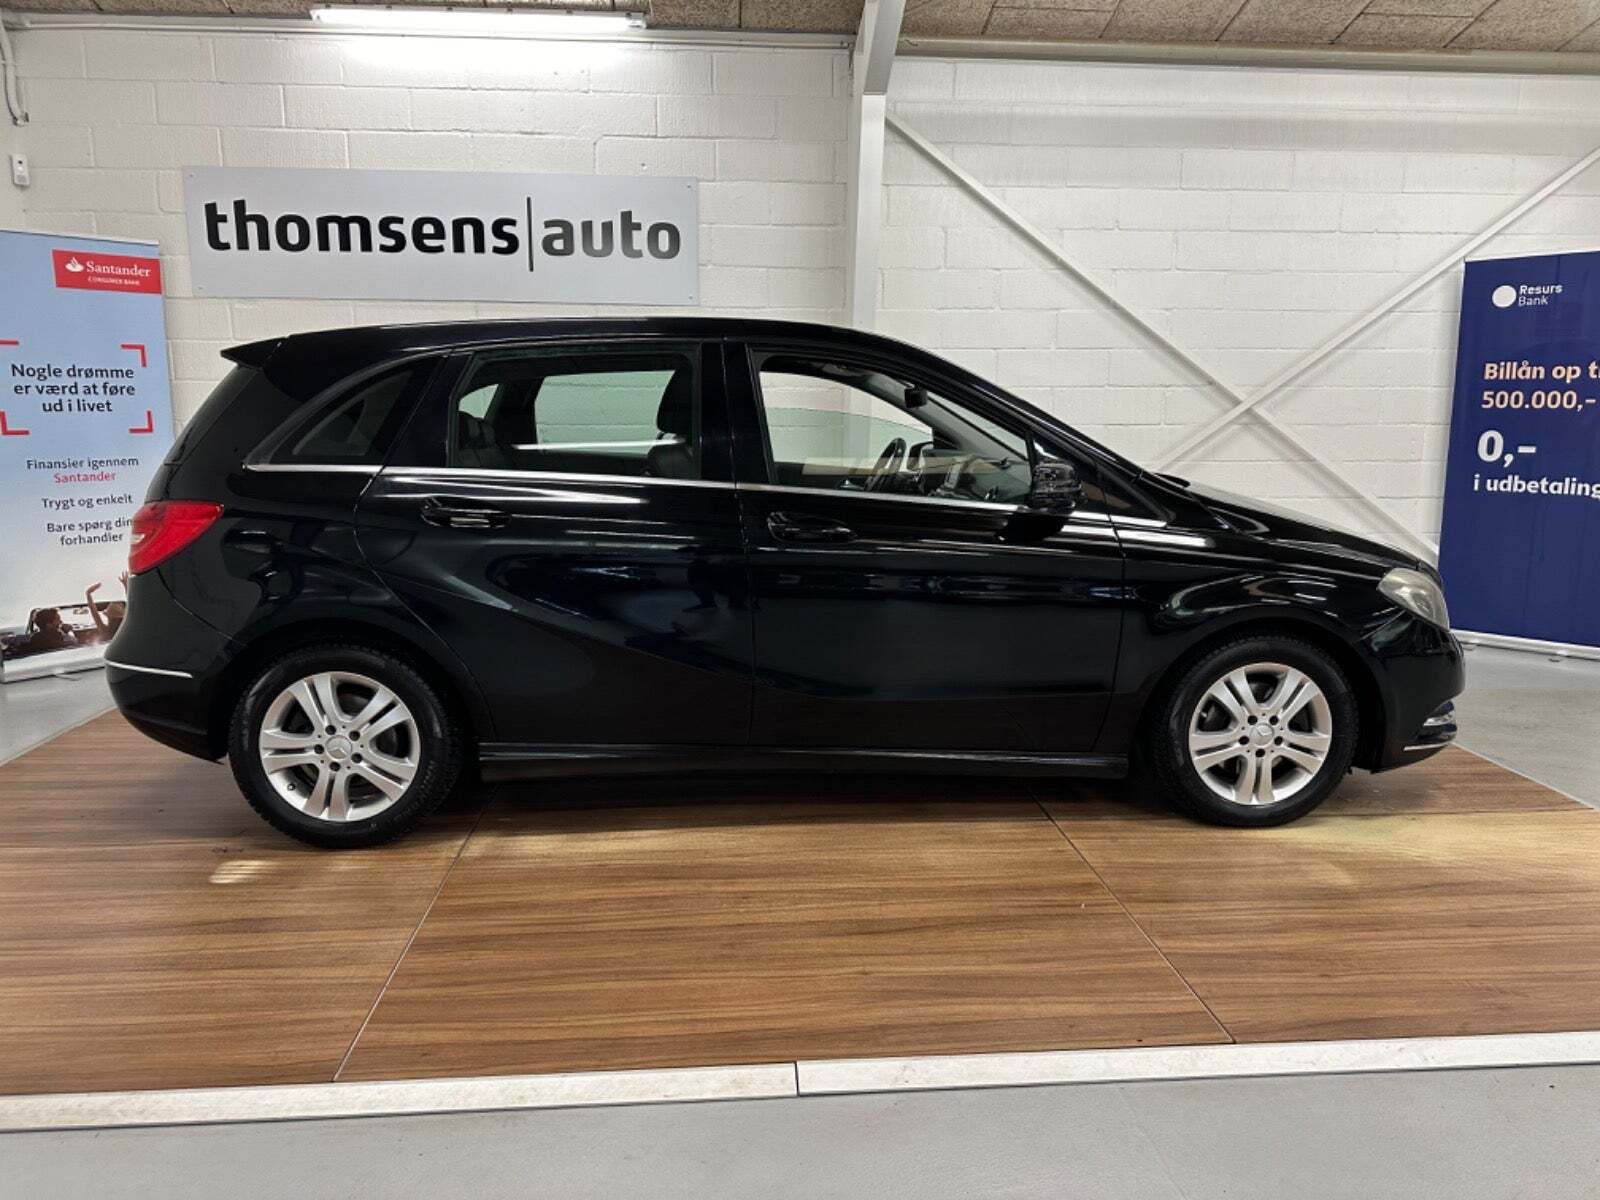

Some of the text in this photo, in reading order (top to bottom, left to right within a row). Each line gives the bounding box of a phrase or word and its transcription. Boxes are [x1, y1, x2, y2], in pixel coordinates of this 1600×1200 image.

[541, 210, 681, 260] auto
[86, 260, 151, 277] Santander
[1519, 284, 1563, 296] Resurs
[1518, 295, 1549, 307] Bank
[11, 364, 135, 382] Nogle drømme
[1483, 360, 1545, 380] Billån
[1551, 368, 1581, 384] op
[13, 382, 136, 396] er værd at føre
[42, 399, 113, 413] ud i livet
[26, 456, 139, 472] Finansier igennem
[53, 472, 117, 484] Santander
[1473, 473, 1600, 500] i udbetaling
[41, 494, 133, 512] Trygt og enkelt
[47, 516, 133, 533] Bare spørg din
[60, 533, 124, 546] forhandler
